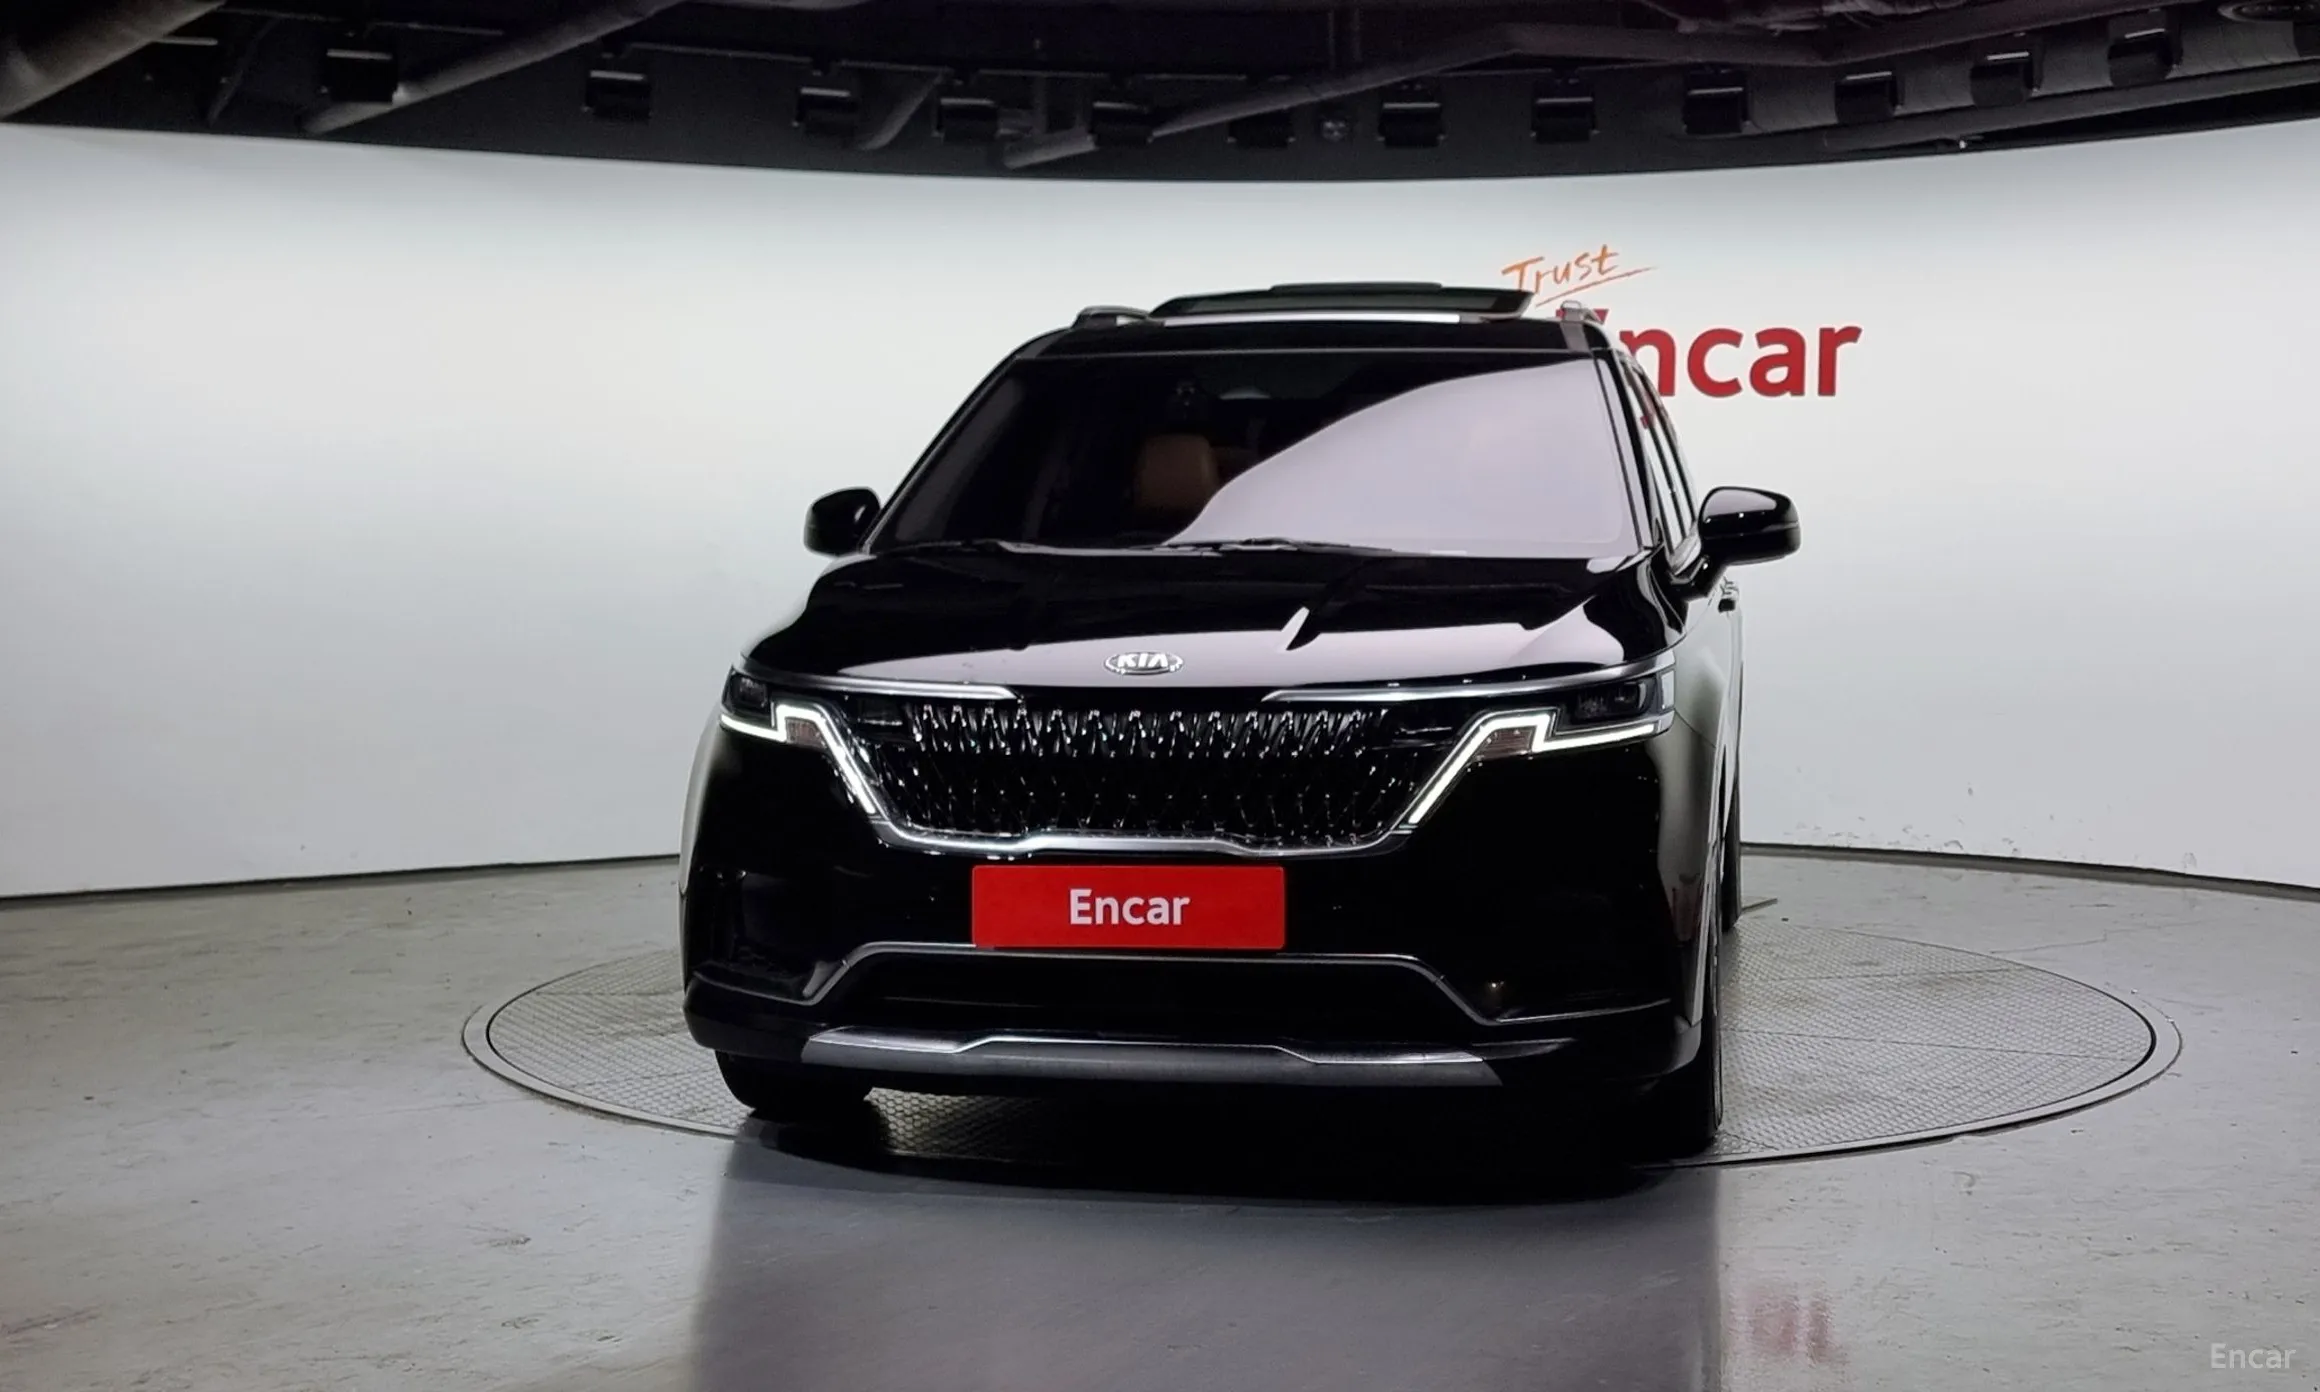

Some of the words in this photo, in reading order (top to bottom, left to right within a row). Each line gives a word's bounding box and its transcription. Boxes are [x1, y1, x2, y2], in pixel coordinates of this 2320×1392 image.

[1501, 244, 1619, 294] Trust
[1556, 308, 1863, 398] ncar
[1117, 652, 1169, 668] KIA
[1069, 888, 1191, 925] Encar
